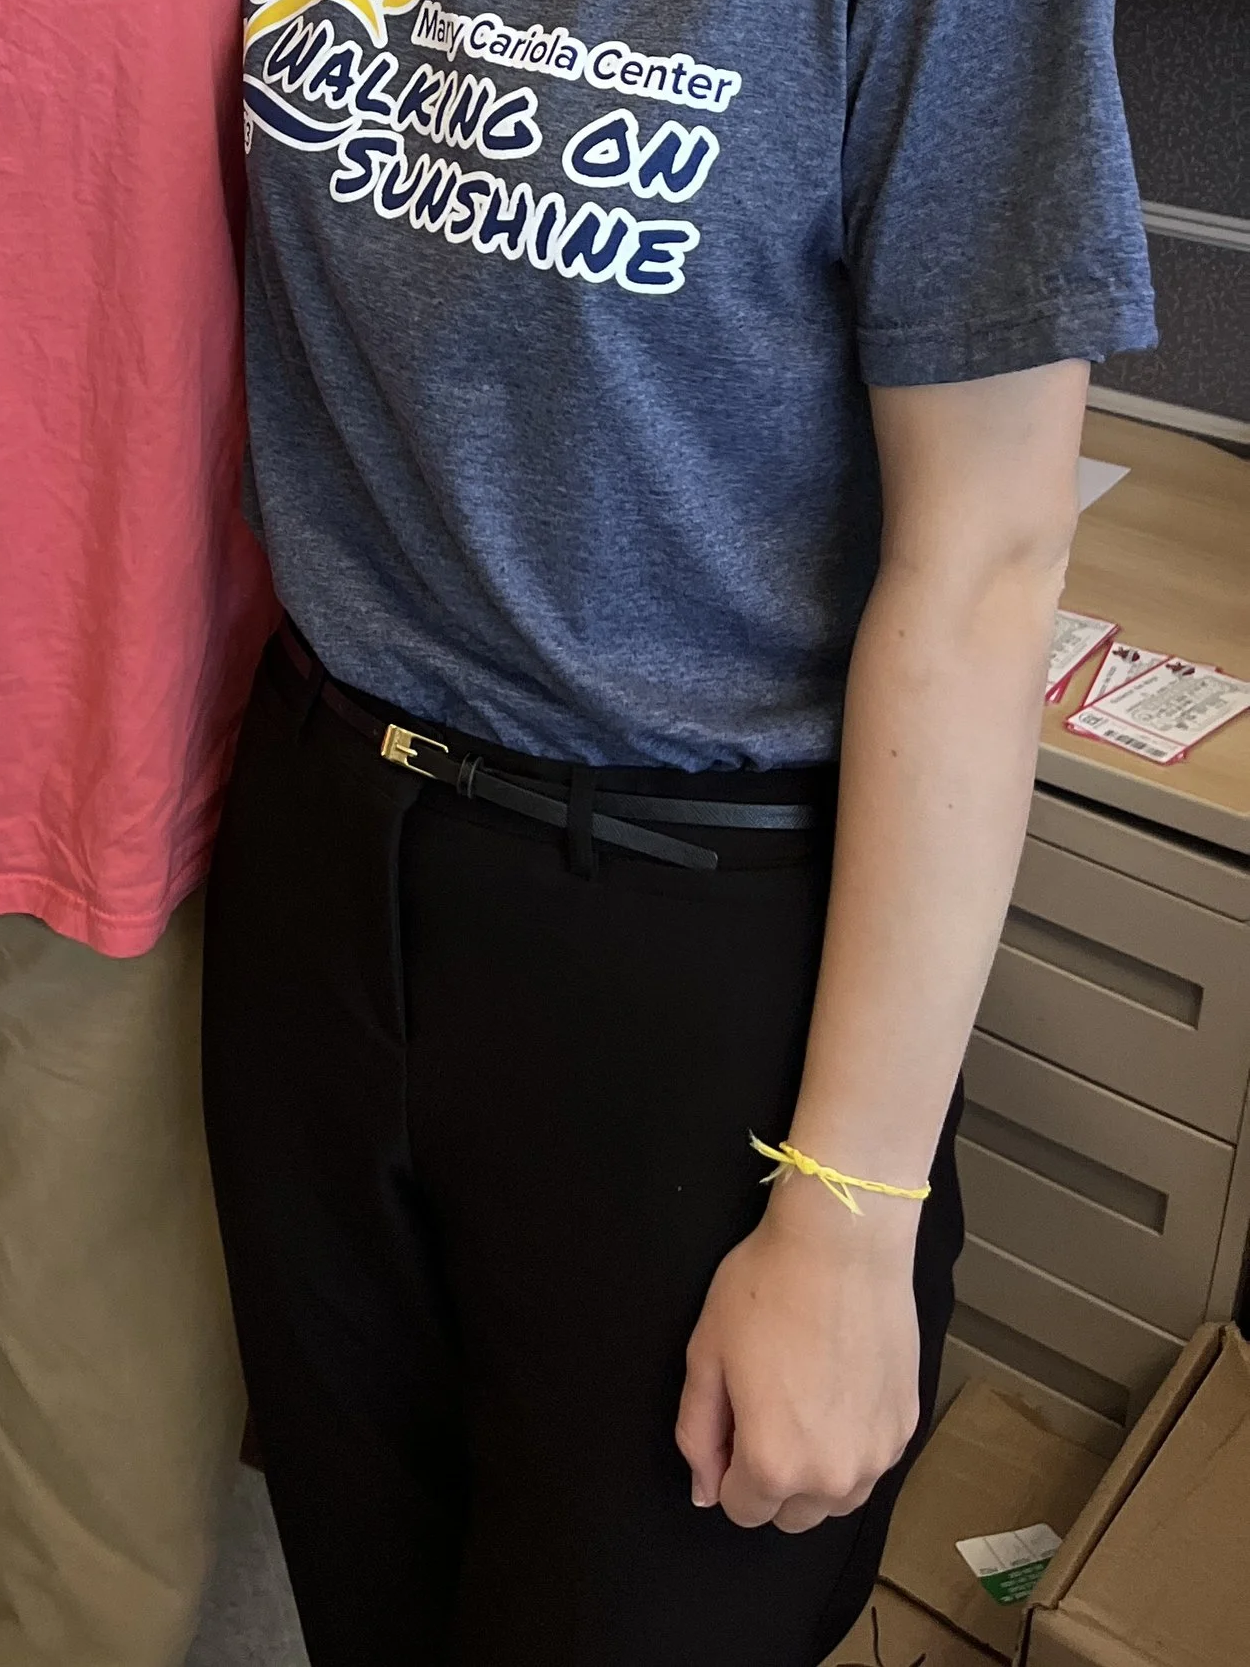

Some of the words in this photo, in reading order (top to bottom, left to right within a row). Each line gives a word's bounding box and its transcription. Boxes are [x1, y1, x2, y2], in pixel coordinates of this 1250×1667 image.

[268, 21, 534, 150] WALKING
[571, 118, 710, 193] ON
[417, 7, 464, 56] Mary
[469, 20, 579, 72] Cariola
[593, 48, 733, 103] Center
[335, 137, 690, 285] SUNSHINE
